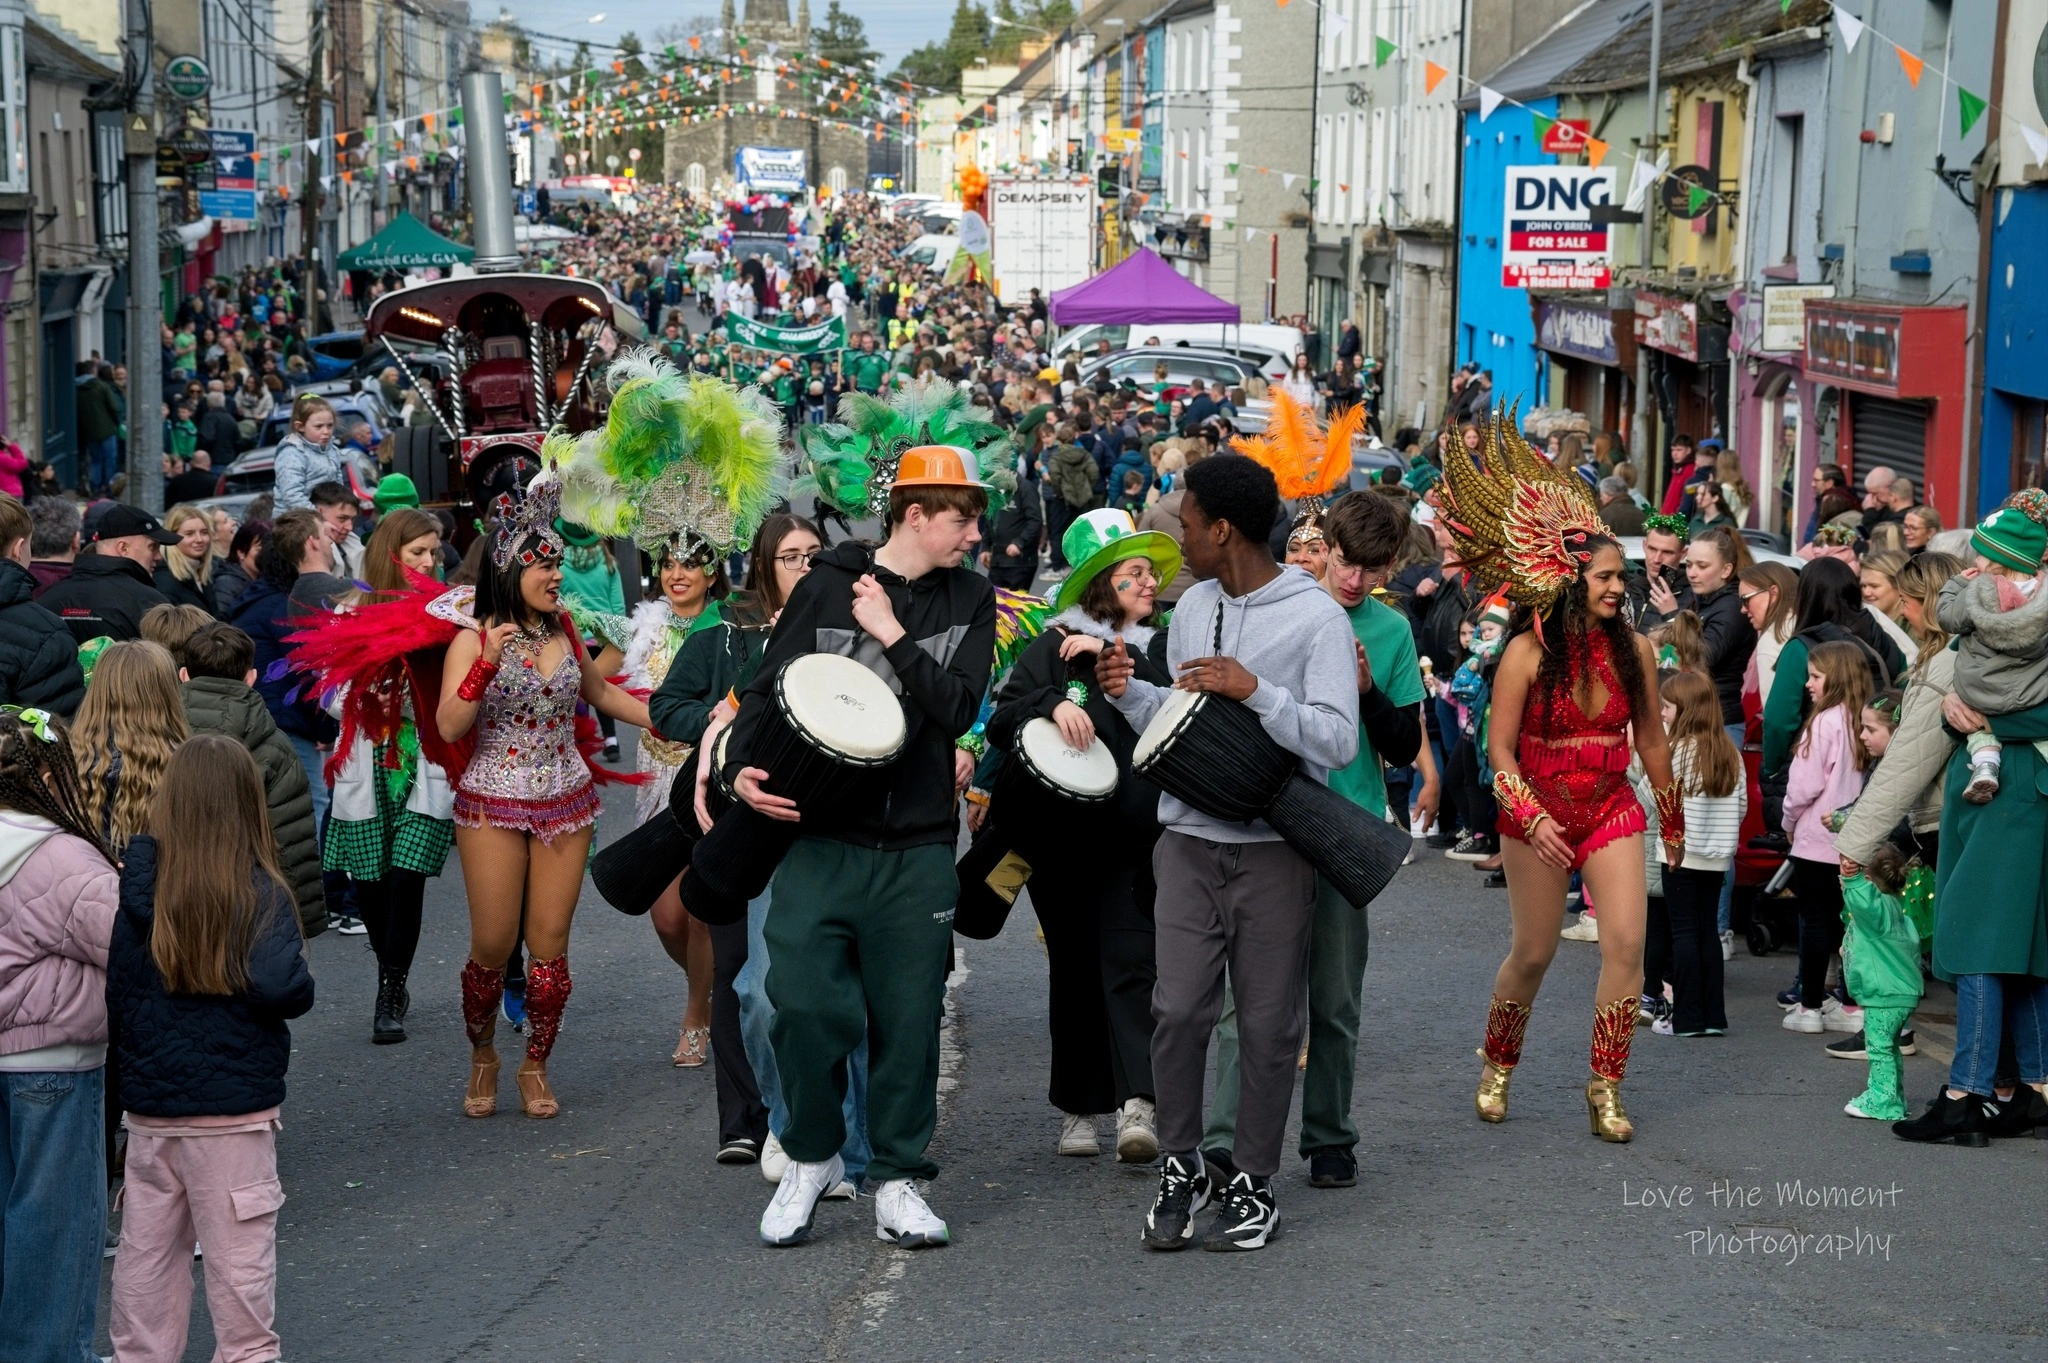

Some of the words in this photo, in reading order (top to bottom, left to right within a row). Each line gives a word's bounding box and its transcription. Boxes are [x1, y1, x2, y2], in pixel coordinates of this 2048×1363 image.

[998, 193, 1087, 203] DEMPSEY
[1515, 177, 1610, 211] DNG
[1526, 221, 1552, 231] JOHN
[1554, 221, 1592, 231] O'BRIEN
[1528, 236, 1554, 248] FOR
[1557, 236, 1588, 249] SALE
[432, 253, 459, 264] GAA
[1522, 266, 1547, 276] Two
[1548, 266, 1573, 276] Bed
[1575, 266, 1605, 277] Apts
[1529, 277, 1567, 287] Retail
[1569, 277, 1596, 288] Unit
